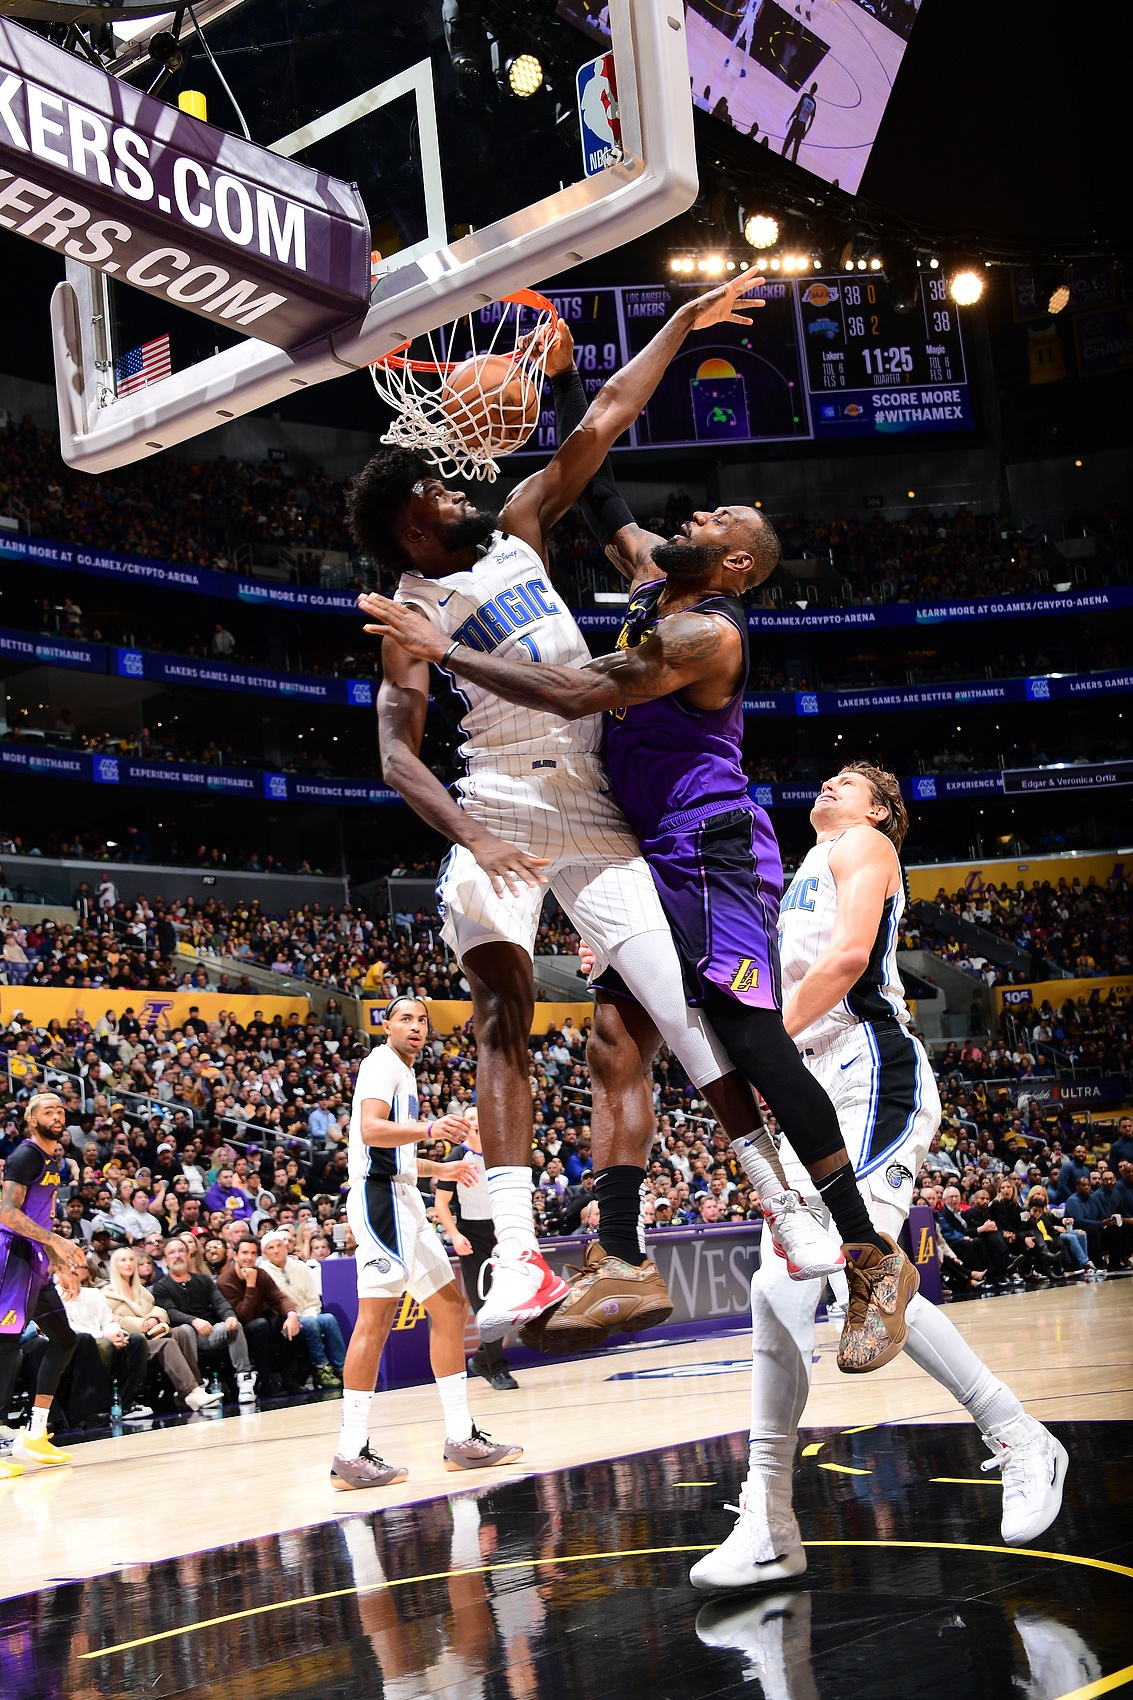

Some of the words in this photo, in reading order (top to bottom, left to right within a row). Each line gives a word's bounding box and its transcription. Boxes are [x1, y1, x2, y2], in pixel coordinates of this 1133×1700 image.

[0, 169, 288, 326] ERS.COM
[626, 292, 638, 301] LOS
[640, 291, 671, 301] ANGELES
[845, 286, 861, 305] 38
[867, 284, 876, 304] 0
[929, 280, 946, 300] 38
[627, 303, 665, 317] LAKERS
[848, 317, 864, 336] 36
[871, 315, 879, 335] 2
[933, 311, 951, 332] 38
[822, 351, 844, 361] Lakers
[926, 345, 946, 356] Magic
[822, 363, 834, 375] TOL
[862, 347, 914, 374] 11:25
[929, 357, 941, 369] TOL
[824, 376, 836, 388] FLS
[840, 375, 845, 386] 0
[873, 374, 901, 385] QUARTER
[930, 370, 943, 381] FLS
[947, 369, 952, 380] 0
[872, 392, 918, 407] SCORE
[922, 390, 961, 404] MORE
[874, 406, 963, 424] #WITHAMEX
[29, 545, 58, 560] MORE
[60, 552, 73, 562] AT
[77, 555, 199, 586] GO.AMEX/CRYPTO-ARENA
[492, 550, 518, 564] Disney
[238, 584, 268, 598] LEARN
[269, 589, 296, 602] MORE
[297, 594, 307, 603] AT
[916, 607, 947, 618] LEARN
[949, 606, 975, 616] MORE
[978, 605, 988, 614] AT
[991, 595, 1109, 613] GO.AMEX/CRYPTO-ARENA
[451, 579, 561, 654] MAGIC
[749, 617, 759, 625] AT
[762, 613, 875, 626] GO.AMEX/CRYPTO-ARENA
[0, 637, 33, 653] BETTER
[36, 645, 91, 662] #WITHAMEX
[518, 633, 541, 662] 1
[164, 664, 198, 678] LAKERS
[200, 670, 228, 682] GAMES
[230, 675, 246, 685] ARE
[248, 676, 277, 689] BETTER
[279, 682, 327, 695] #WITHAMEX
[1070, 681, 1103, 691] LAKERS
[838, 698, 870, 708] LAKERS
[872, 695, 900, 705] GAMES
[903, 694, 919, 703] ARE
[921, 692, 951, 702] BETTER
[954, 688, 1005, 699] #WITHAMEX
[2, 752, 27, 764] MORE
[29, 755, 81, 771] #WITHAMEX
[129, 767, 181, 781] EXPERIENCE
[182, 773, 205, 784] MORE
[207, 776, 254, 788] #WITHAMEX
[946, 780, 994, 791] EXPERIENCE
[1022, 780, 1046, 790] Edgar
[1048, 778, 1055, 786] &
[1057, 775, 1093, 786] Veronica
[1095, 773, 1116, 783] Ortiz
[296, 785, 342, 797] EXPERIENCE
[344, 789, 367, 798] MORE
[729, 957, 759, 992] LA
[1004, 991, 1029, 1004] 105
[372, 1010, 386, 1023] 10
[1061, 1086, 1101, 1099] ULTRA
[915, 1227, 934, 1265] LA
[391, 1291, 427, 1331] LA
[604, 1302, 619, 1317] 23
